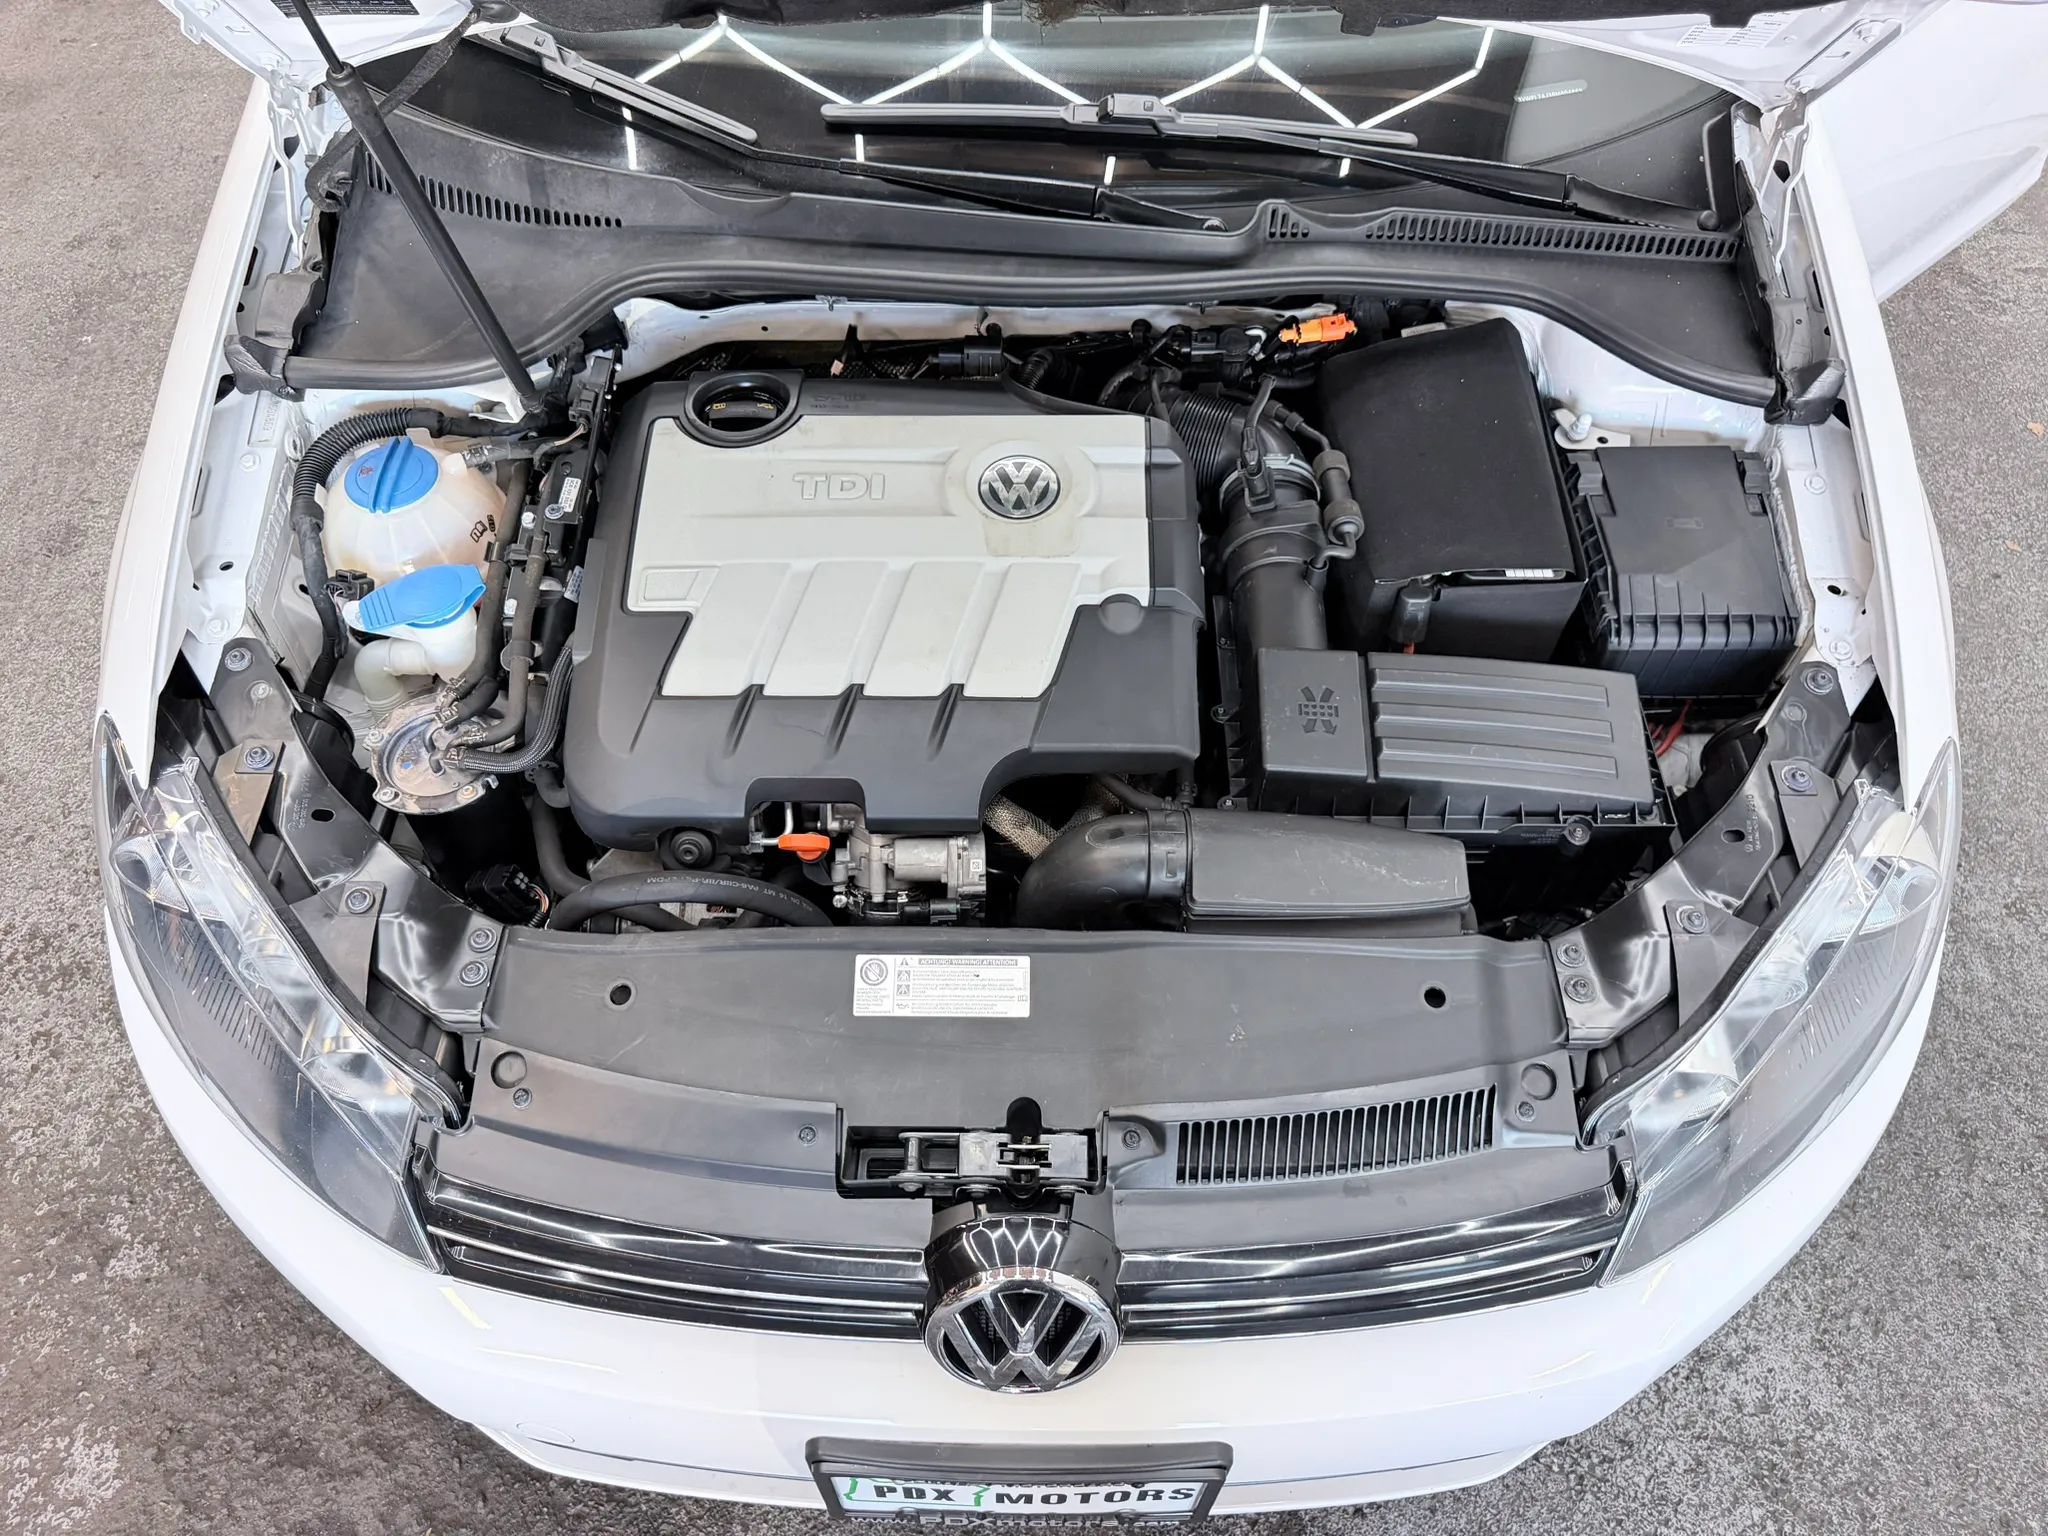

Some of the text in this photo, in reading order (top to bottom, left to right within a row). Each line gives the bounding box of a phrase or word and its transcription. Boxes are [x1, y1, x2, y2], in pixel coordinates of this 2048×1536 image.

[792, 473, 885, 500] TDI
[873, 1484, 956, 1502] PDX
[995, 1487, 1196, 1505] MOTORS
